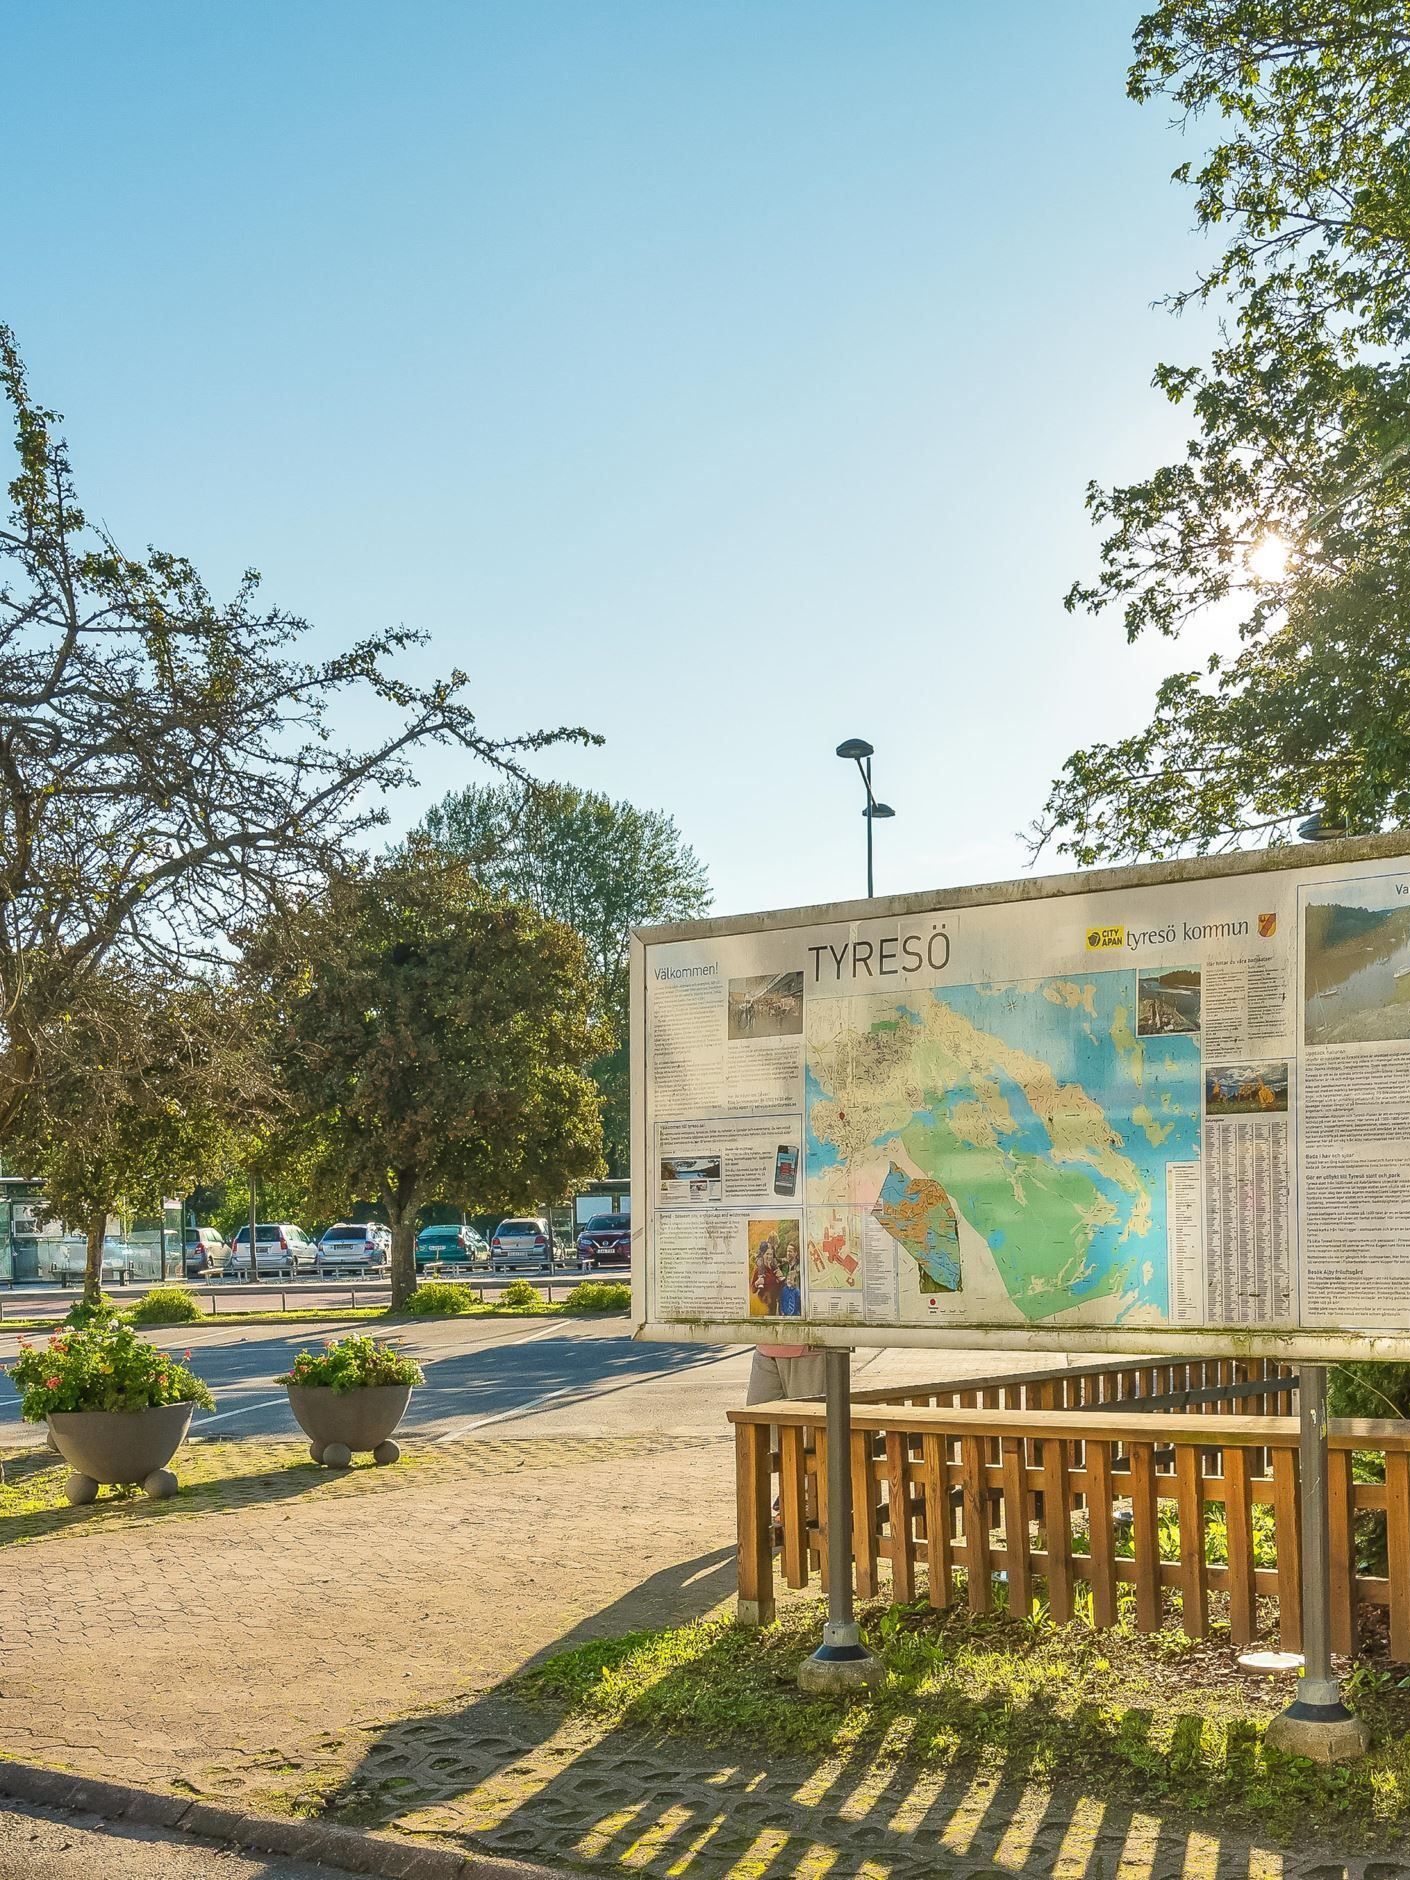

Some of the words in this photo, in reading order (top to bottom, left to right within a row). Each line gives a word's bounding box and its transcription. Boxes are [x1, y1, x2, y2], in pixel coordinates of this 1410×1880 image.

[1101, 928, 1119, 938] CITY
[1101, 937, 1123, 947] APAN
[1126, 926, 1176, 951] tyresö
[1183, 920, 1249, 941] kommun
[807, 923, 951, 982] TYRESÖ
[654, 962, 719, 980] Välkommen!
